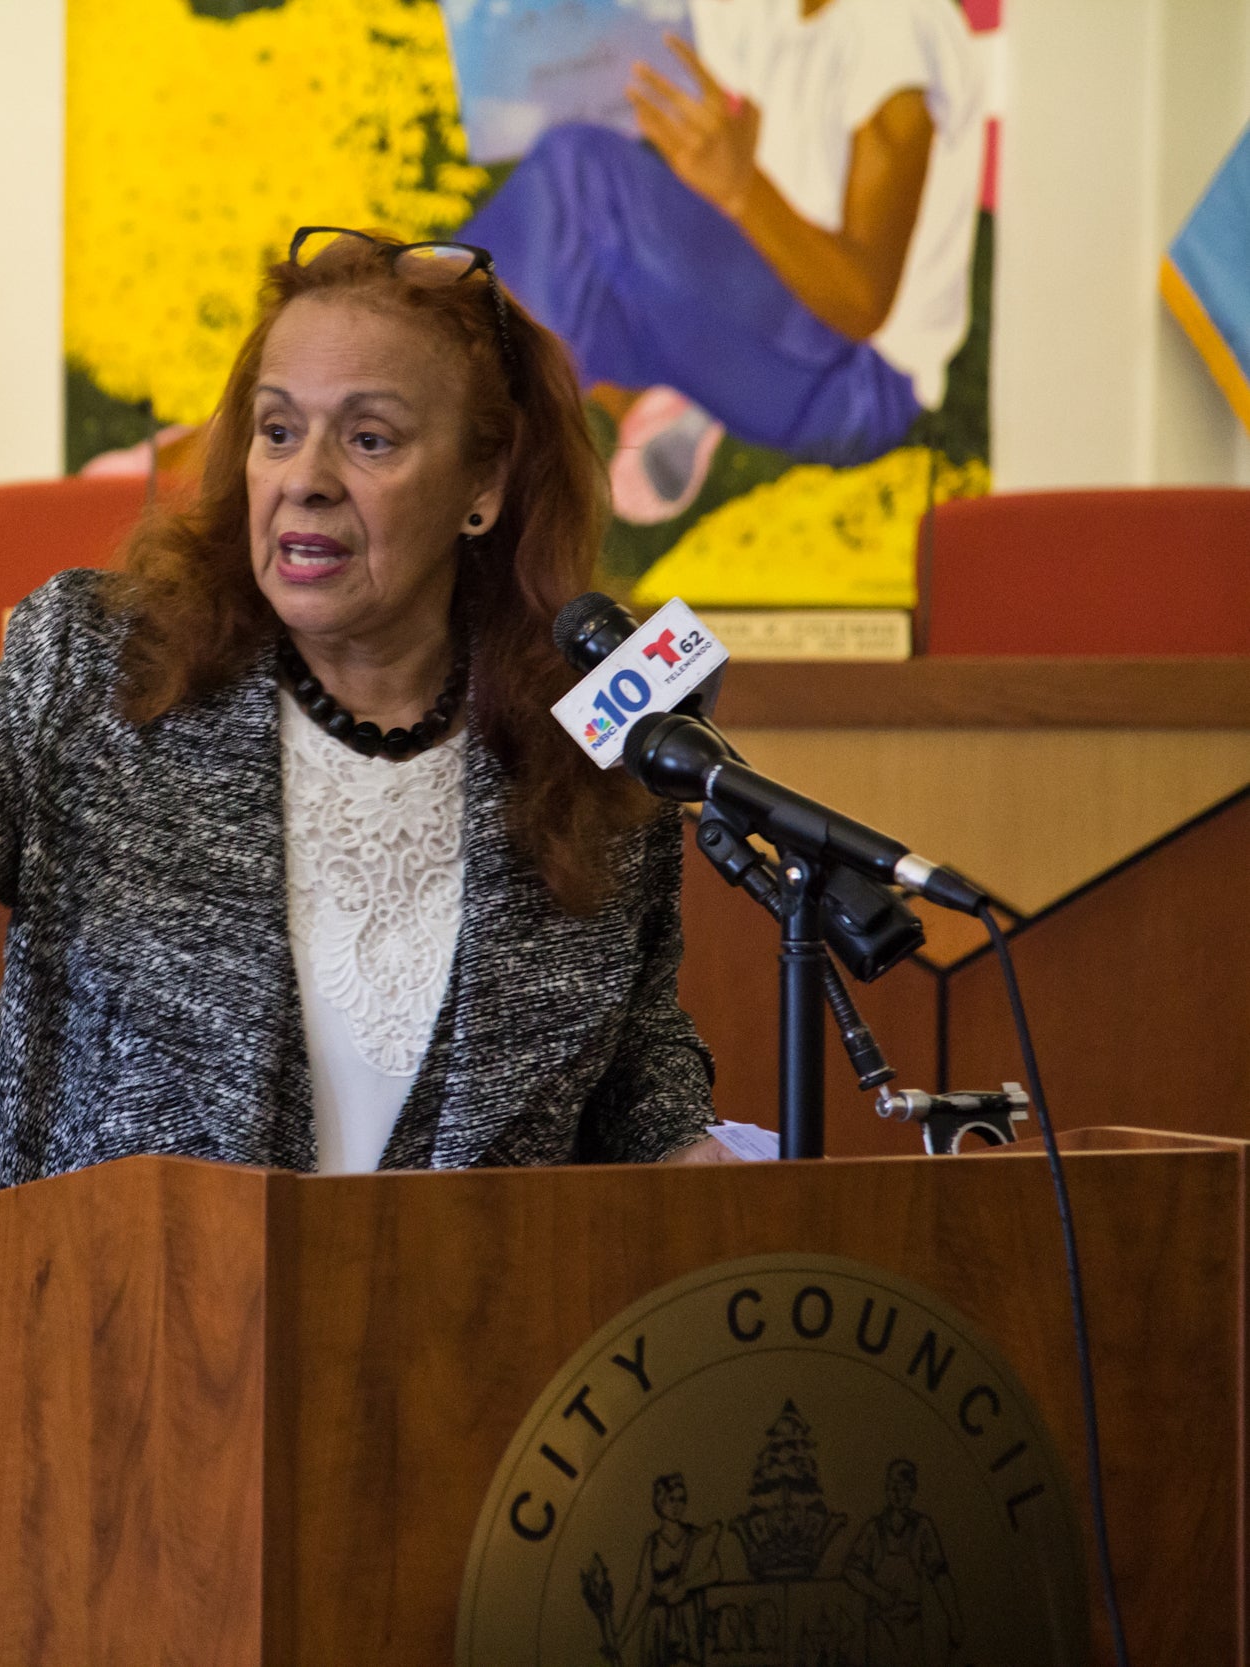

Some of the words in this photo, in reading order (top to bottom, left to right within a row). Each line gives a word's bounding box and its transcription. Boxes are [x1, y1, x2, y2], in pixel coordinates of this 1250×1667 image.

[664, 641, 713, 685] TELEMUNDO
[679, 630, 705, 655] 62
[592, 669, 652, 729] 10
[591, 726, 618, 750] NBC
[510, 1336, 654, 1542] CITY
[727, 1285, 1046, 1533] COUNCIL
